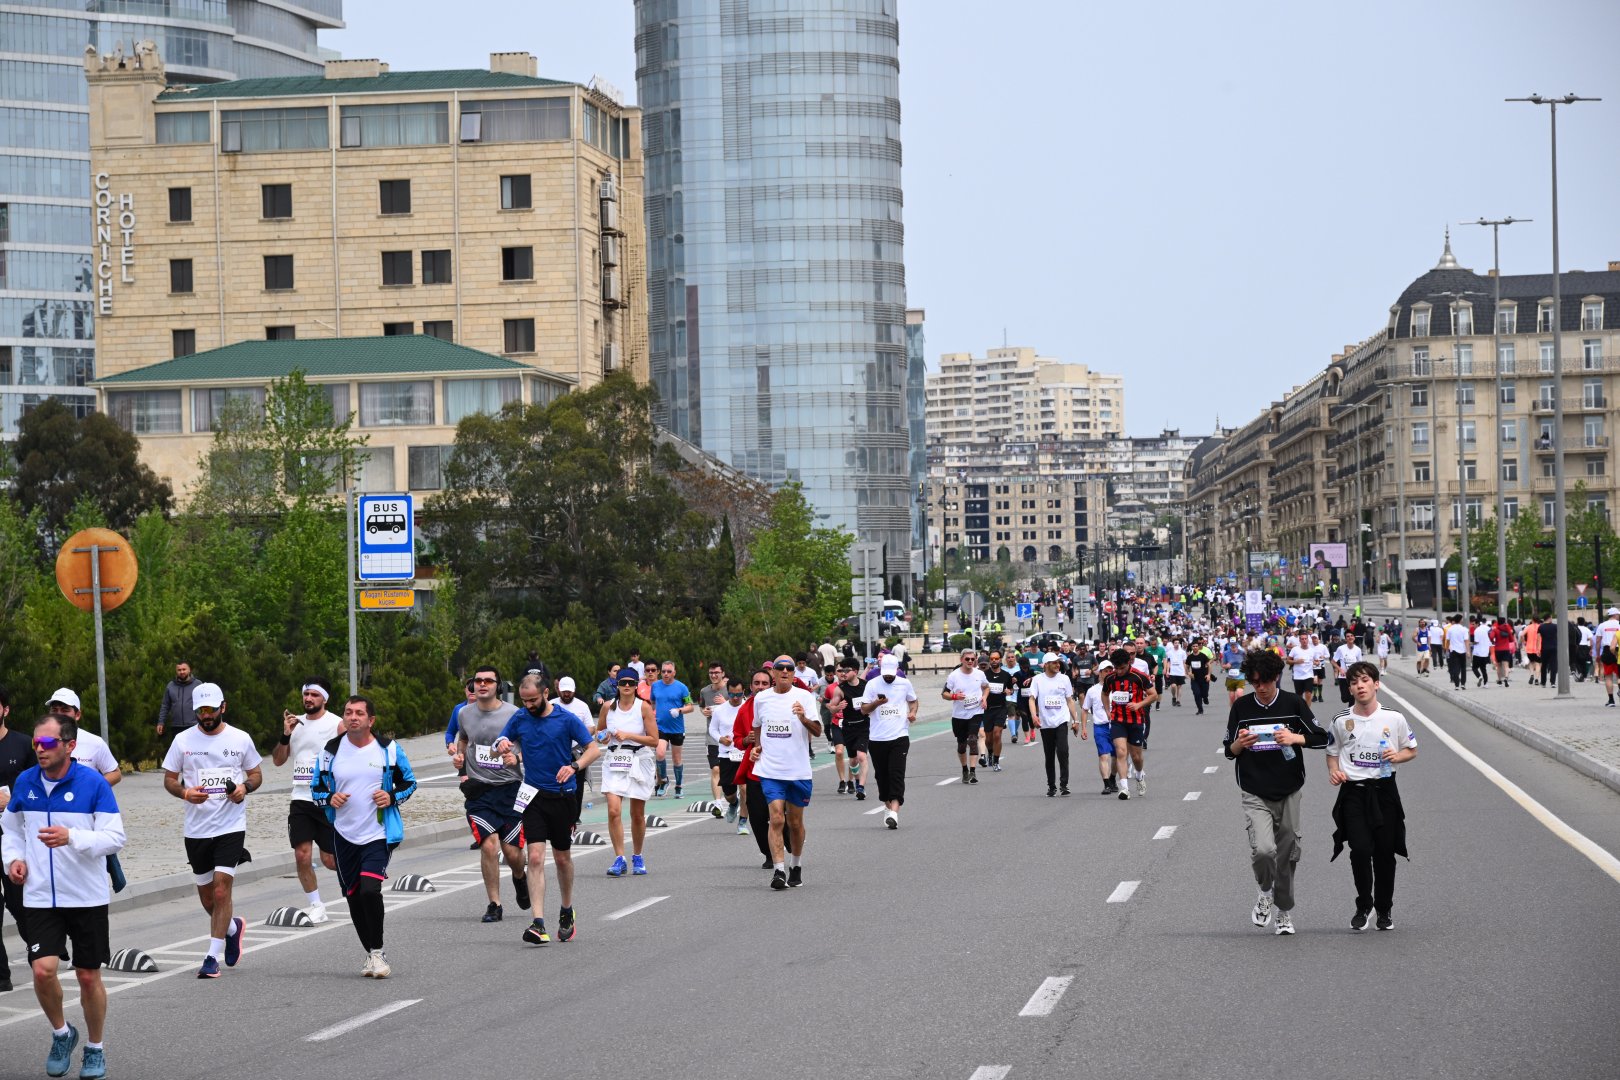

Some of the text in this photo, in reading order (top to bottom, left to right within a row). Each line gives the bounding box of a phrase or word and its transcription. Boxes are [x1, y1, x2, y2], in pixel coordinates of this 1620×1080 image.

[95, 172, 113, 315] CORNICHE
[119, 192, 136, 283] HOTEL
[373, 503, 398, 512] BUS
